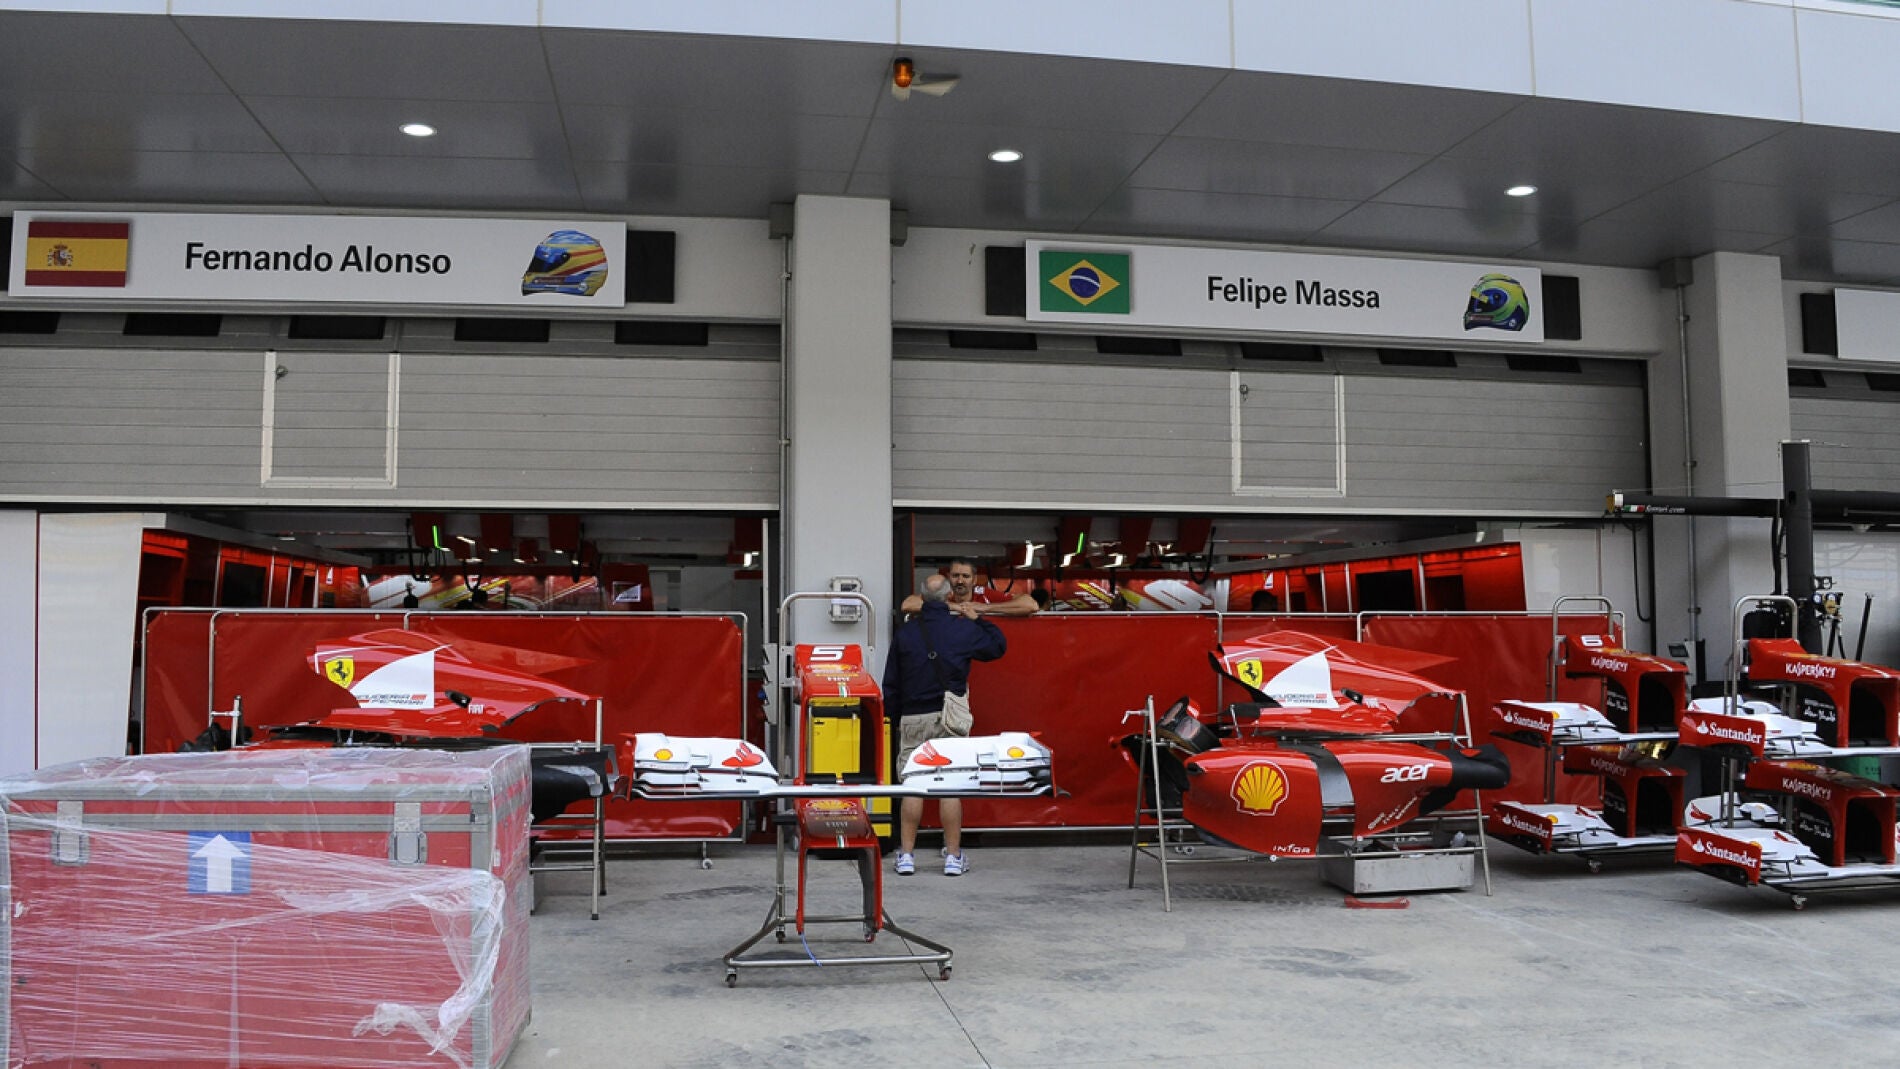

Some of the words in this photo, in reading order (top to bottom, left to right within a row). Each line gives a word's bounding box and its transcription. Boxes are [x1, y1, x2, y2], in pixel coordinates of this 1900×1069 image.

[184, 242, 333, 272] Fernando
[339, 245, 451, 274] Alonso
[1207, 276, 1287, 309] Felipe
[1296, 280, 1380, 308] Massa
[1581, 635, 1603, 647] 6
[810, 646, 846, 661] 5
[1513, 712, 1551, 733] Santander
[1709, 721, 1762, 744] Santander
[1380, 763, 1434, 783] acer
[1511, 816, 1550, 839] Santander
[1705, 840, 1759, 869] Santander
